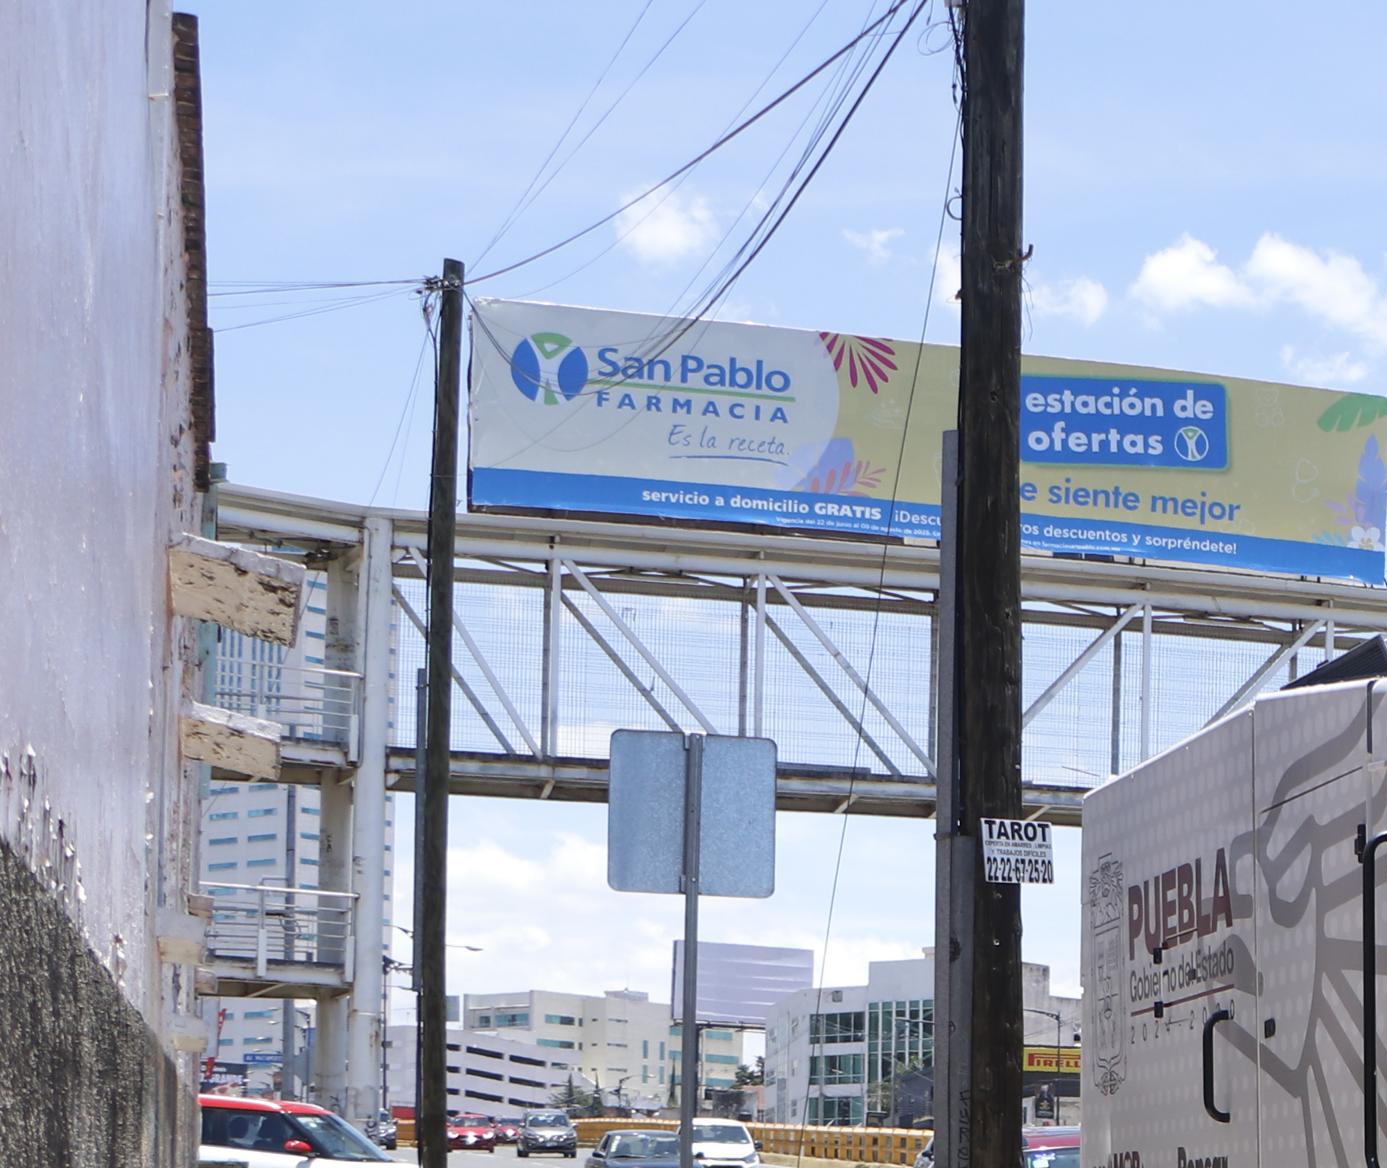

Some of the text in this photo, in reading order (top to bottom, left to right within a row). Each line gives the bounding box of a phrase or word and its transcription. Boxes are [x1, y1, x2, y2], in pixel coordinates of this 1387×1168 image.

[597, 347, 791, 394] San Pablo
[596, 390, 789, 424] FARMACIA
[1025, 387, 1214, 420] estación de
[668, 424, 790, 456] Es la receta.
[1027, 420, 1164, 455] ofertas
[642, 488, 941, 527] servicio a domicilio GRATIS ¡Descu
[1020, 476, 1241, 526] e siente mejor
[1044, 524, 1128, 543] descuentos
[1131, 533, 1141, 546] y
[1145, 534, 1237, 555] sorpréndete!
[984, 820, 1050, 842] TAROT
[1128, 847, 1233, 961] PUEBLA
[1028, 1052, 1081, 1068] PIRELL
